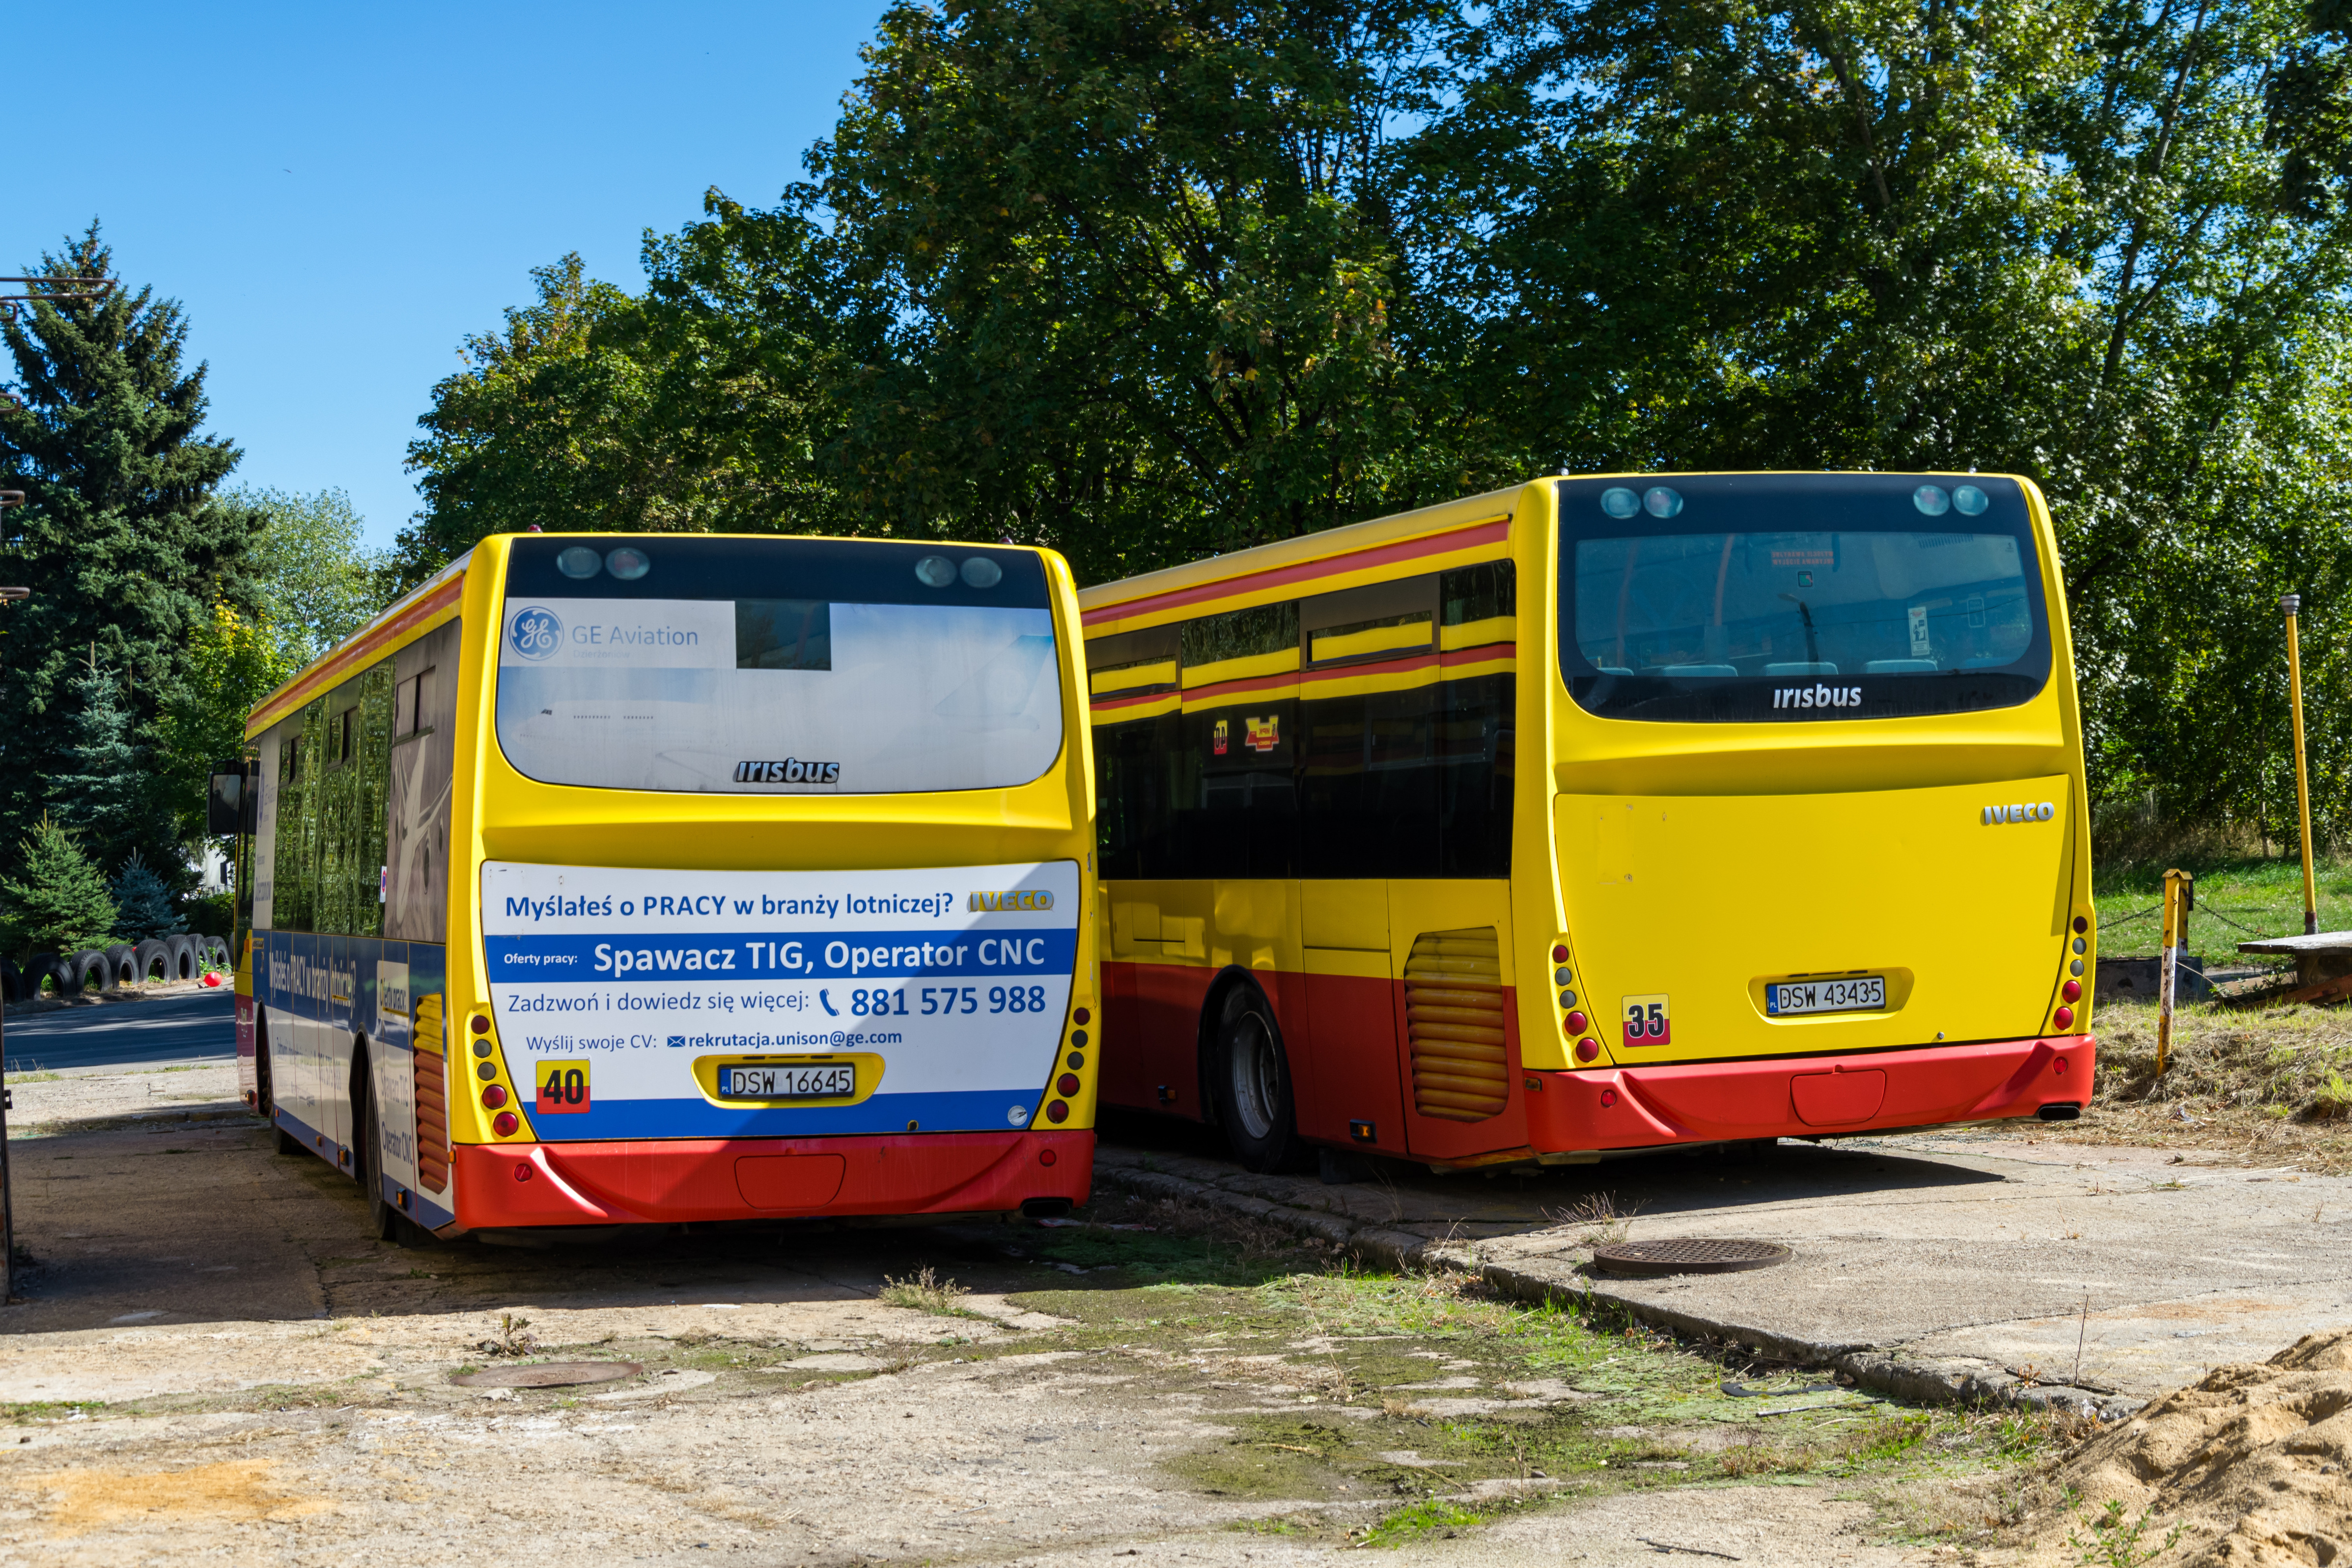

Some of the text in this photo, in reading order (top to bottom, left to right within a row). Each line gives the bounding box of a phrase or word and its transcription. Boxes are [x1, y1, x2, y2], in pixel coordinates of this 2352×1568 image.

[572, 626, 698, 645] GE Aviation
[1773, 683, 1862, 709] irisbus
[737, 758, 840, 783] irisbus
[1984, 801, 2055, 825] IVECO
[506, 893, 953, 922] Myślałeś o PRACY w branży lotniczej?
[969, 891, 1054, 911] IVECO
[504, 938, 1045, 978] Oferty pracy: Spawacz TIG, Operator CNC
[508, 985, 1046, 1016] Zadzwoń i dowiedz się więcej: 881 575 988
[1779, 983, 1816, 1010] DSW
[1823, 980, 1881, 1007] 43435
[1627, 1004, 1665, 1037] 35
[526, 1030, 902, 1053] Wyślij swoje CV: rekrutacja.unison@ge.com
[543, 1068, 585, 1105] 40
[732, 1071, 775, 1094] DSW
[785, 1070, 850, 1093] 16645
